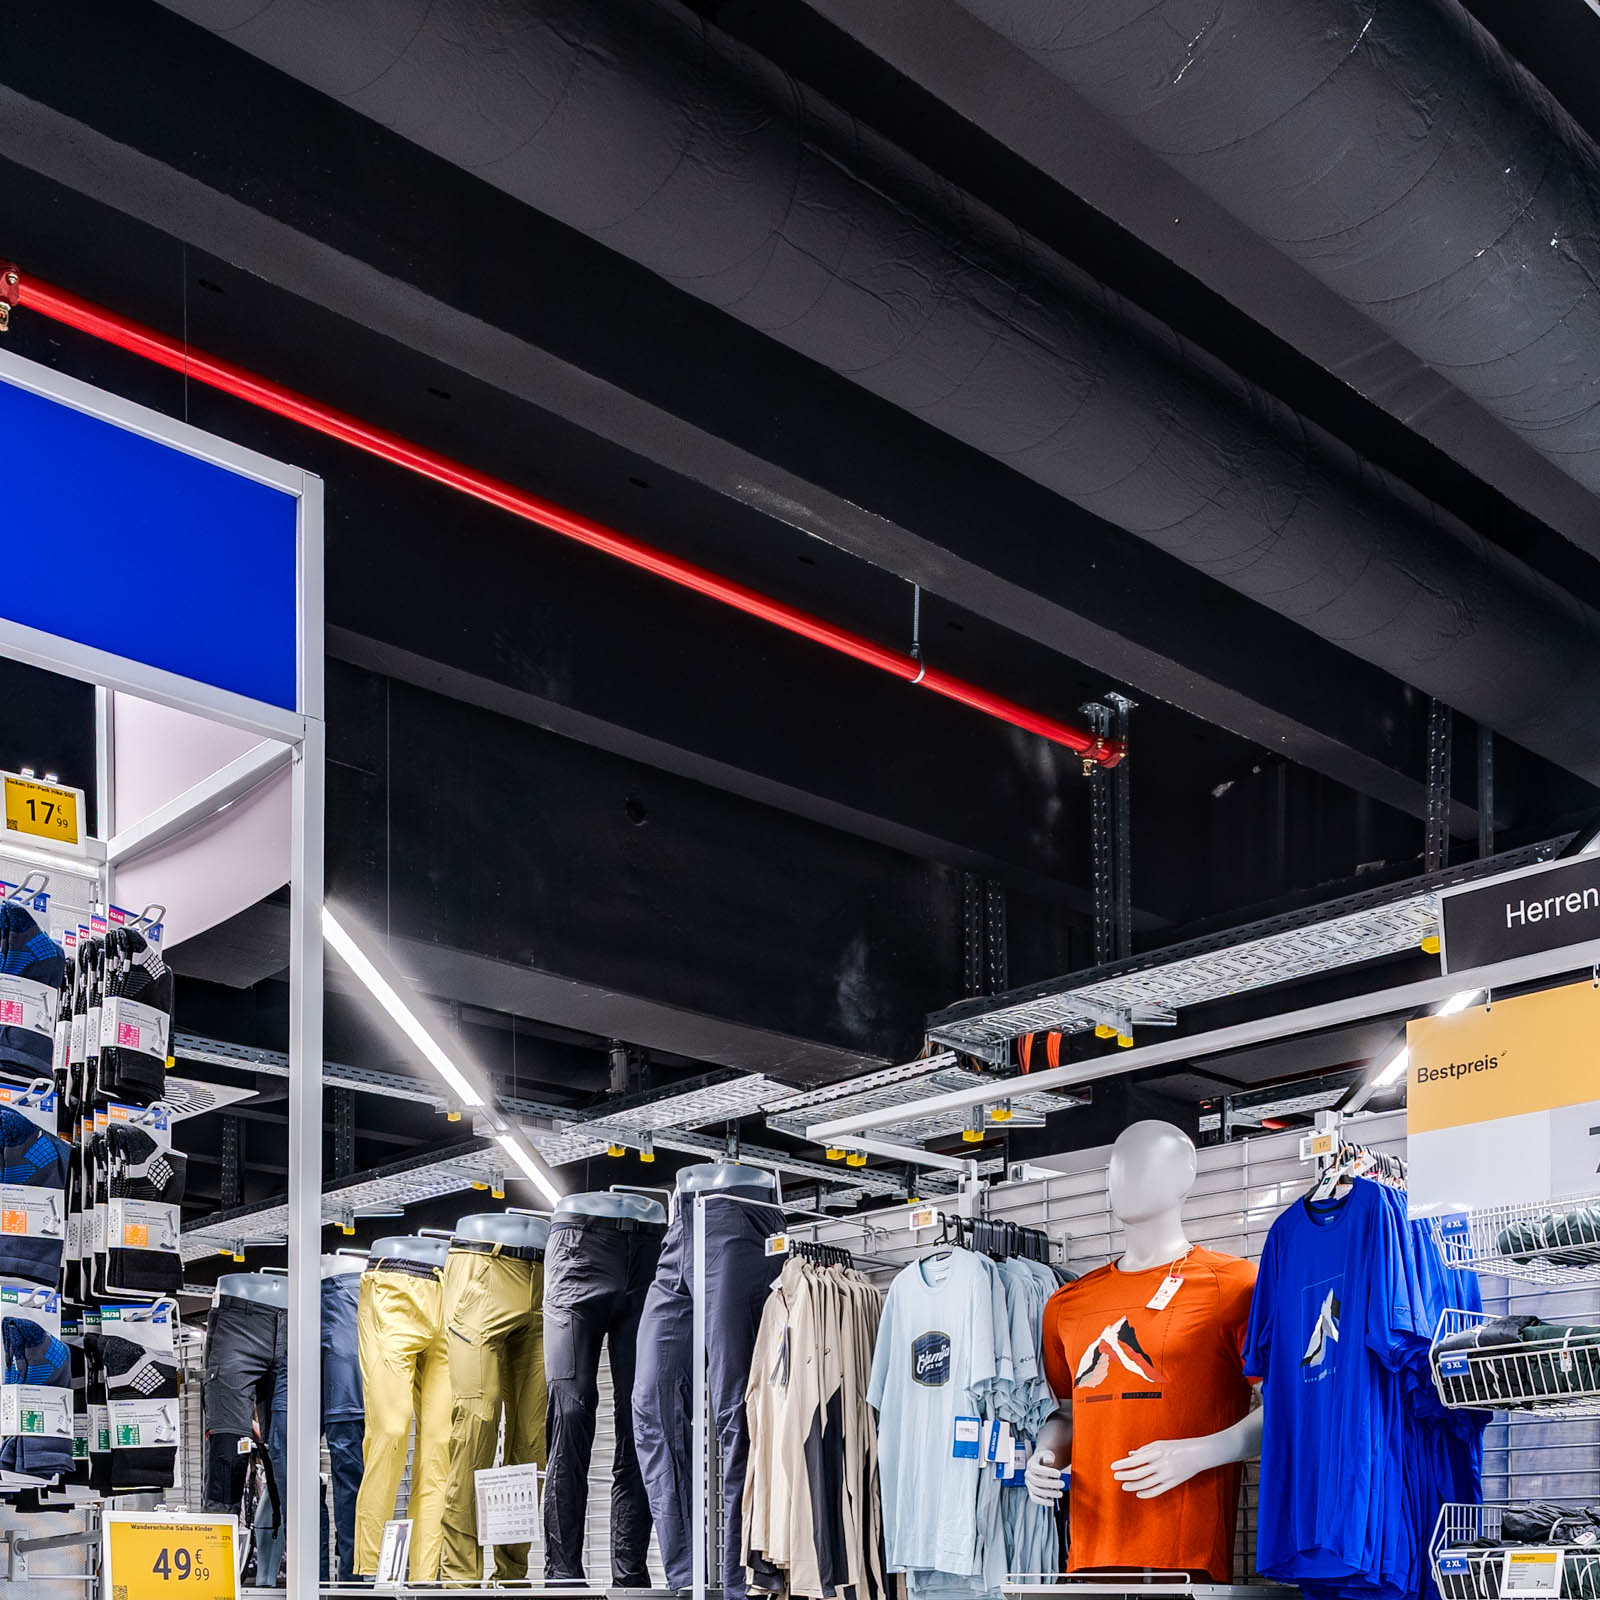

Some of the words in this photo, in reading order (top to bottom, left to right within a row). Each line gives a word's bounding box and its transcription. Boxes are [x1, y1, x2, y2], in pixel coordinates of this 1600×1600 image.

[26, 798, 55, 825] 17
[56, 817, 69, 829] 99
[1506, 886, 1600, 929] Herren
[1417, 1052, 1499, 1084] Bestpreis
[1453, 1220, 1463, 1228] XL
[152, 1548, 192, 1580] 49
[195, 1549, 203, 1564] €
[194, 1568, 210, 1581] 99
